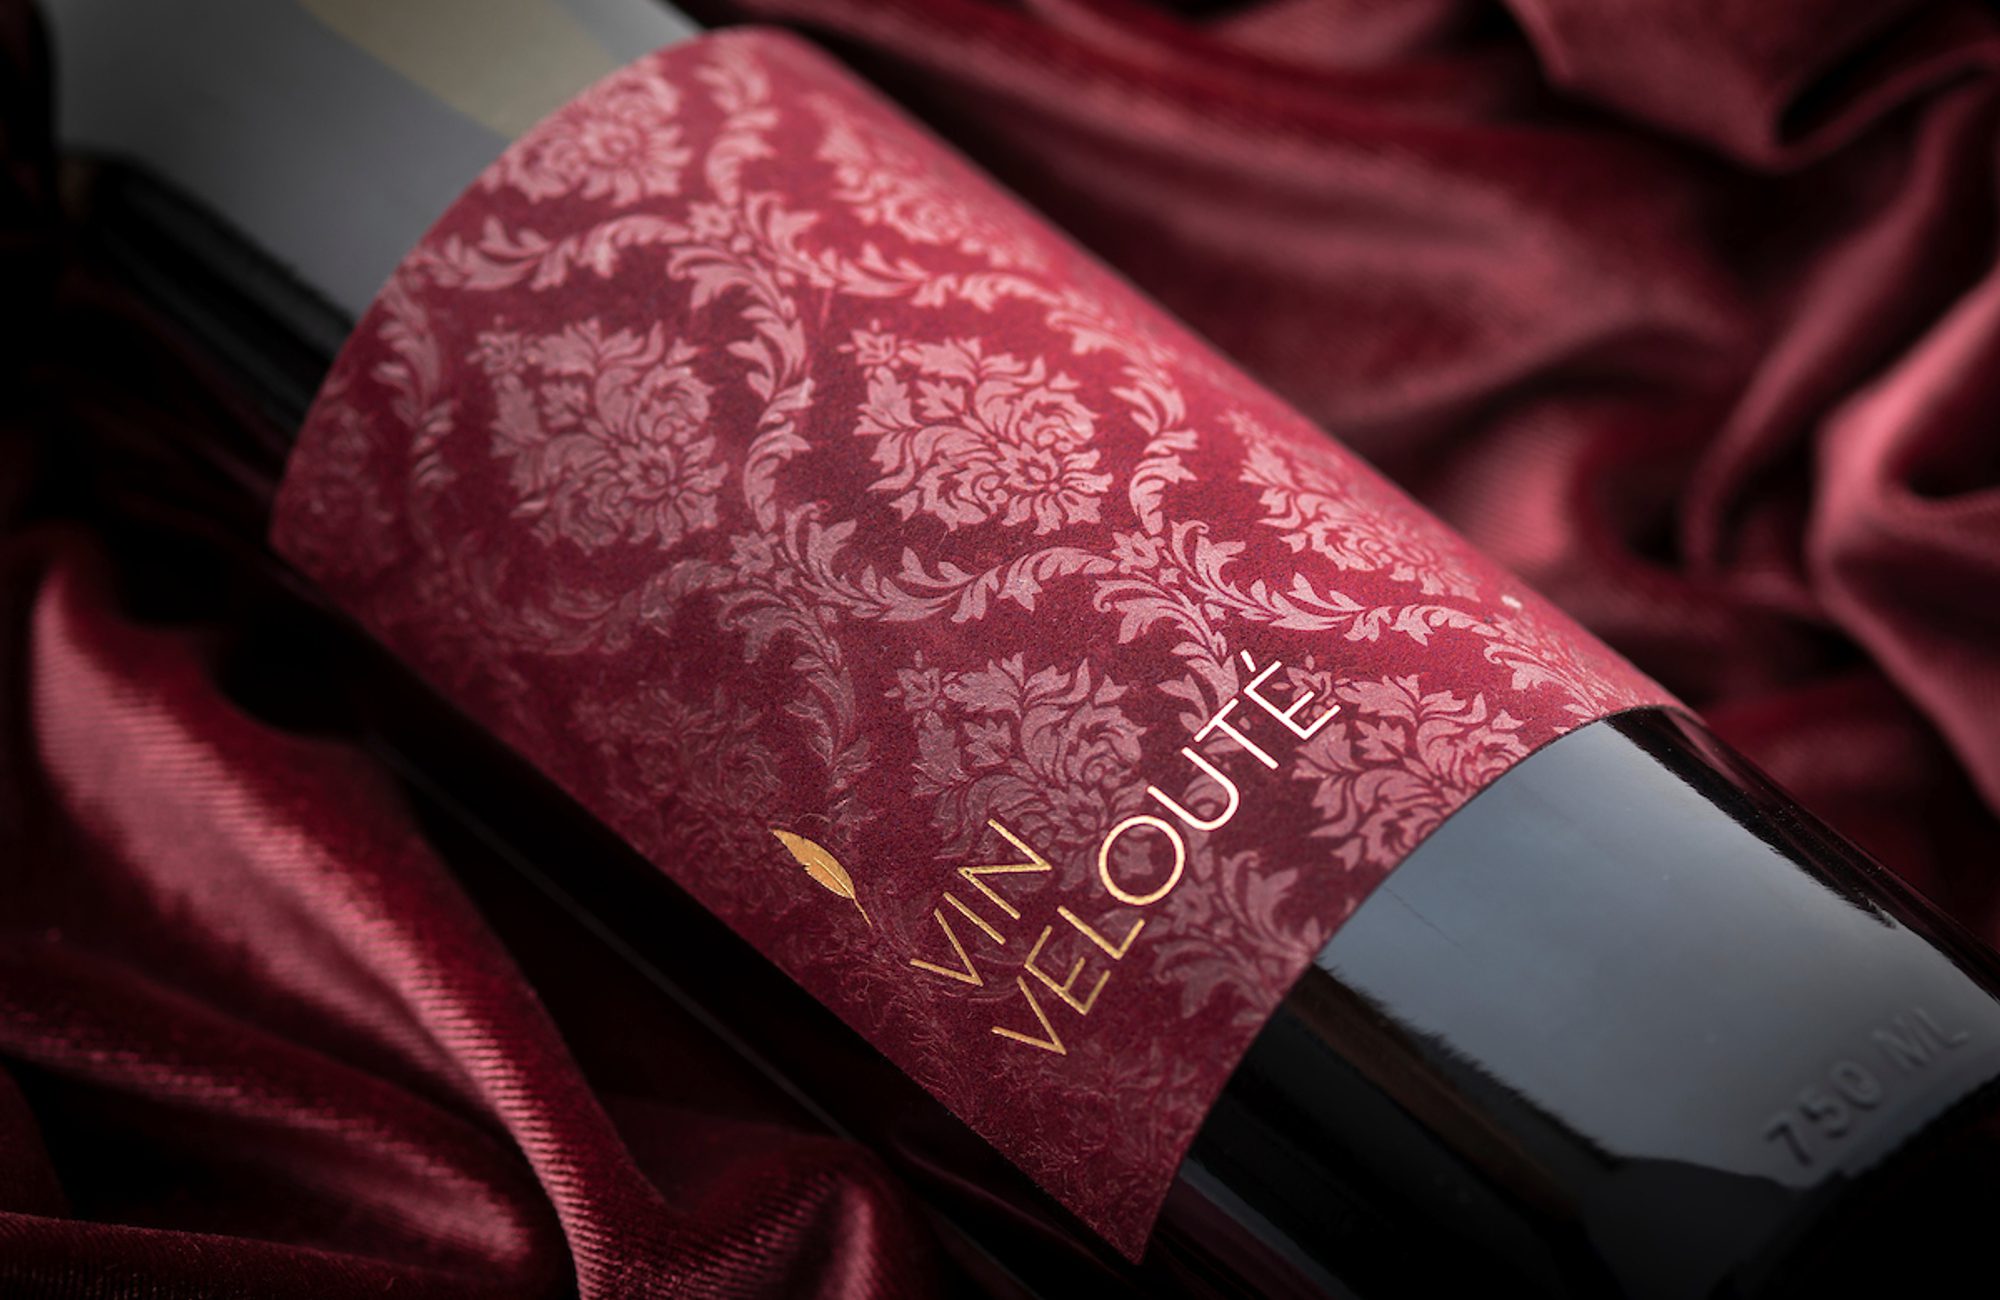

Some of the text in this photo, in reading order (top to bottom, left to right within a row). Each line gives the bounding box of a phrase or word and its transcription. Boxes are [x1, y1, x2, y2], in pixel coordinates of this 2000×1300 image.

[910, 819, 1052, 987] VIN
[991, 650, 1340, 1055] VELOUTÉ
[1763, 1006, 1969, 1166] 750 ML
